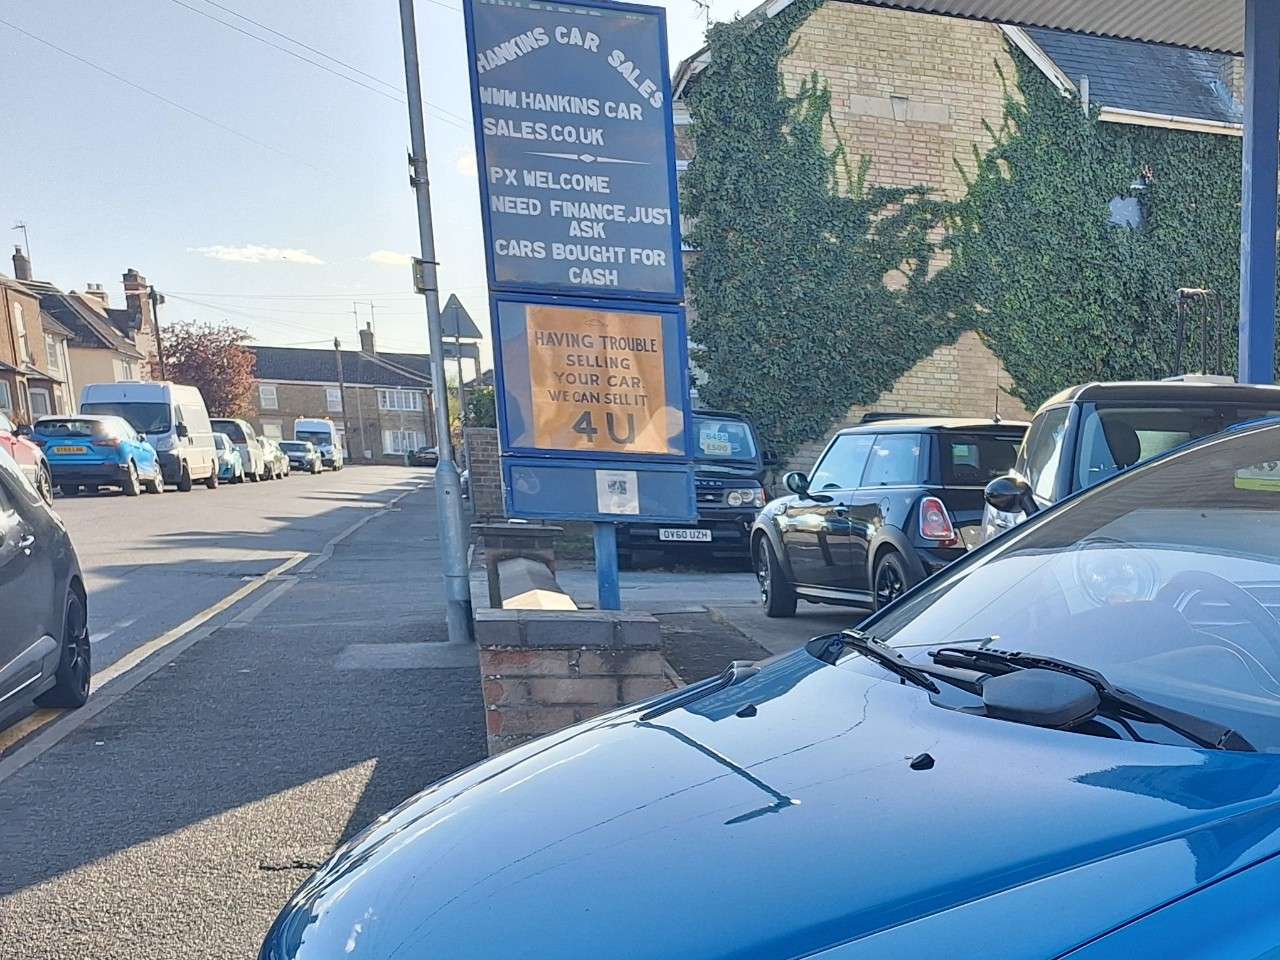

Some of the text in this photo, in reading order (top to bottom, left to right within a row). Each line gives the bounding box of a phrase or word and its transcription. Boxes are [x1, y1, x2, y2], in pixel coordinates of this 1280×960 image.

[477, 26, 664, 109] HANKINS CAR SALES
[605, 101, 643, 120] CAR
[483, 118, 605, 146] SALES.CO.UK
[490, 167, 610, 193] PX WELCOME
[491, 196, 541, 217] NEED
[569, 222, 606, 239] ASK
[495, 239, 666, 266] CARS BOUGHT FOR
[569, 267, 618, 286] CASH
[535, 331, 658, 353] HAVING TROUBLE
[566, 354, 631, 370] SELLING
[554, 371, 646, 389] YOUR CAR.
[548, 390, 648, 407] WE CAN SELL IT
[571, 410, 636, 445] 4 U
